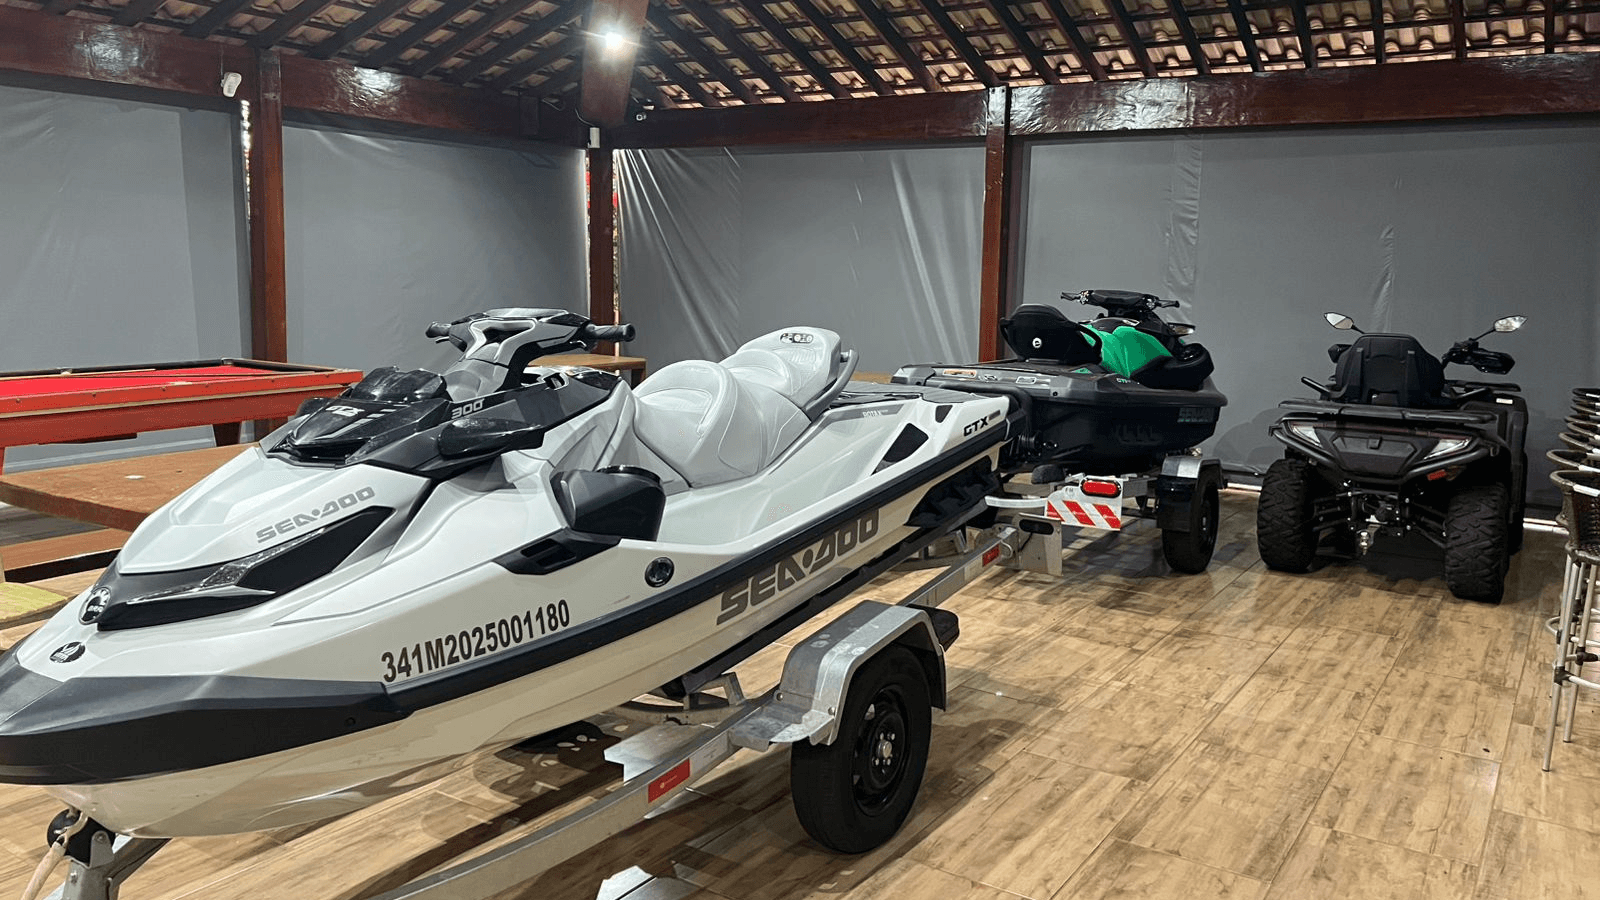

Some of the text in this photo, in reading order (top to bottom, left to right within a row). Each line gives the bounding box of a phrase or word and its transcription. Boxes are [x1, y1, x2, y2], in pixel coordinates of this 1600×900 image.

[451, 398, 485, 419] 300
[963, 416, 988, 437] GTX
[381, 599, 570, 682] 341M2025001180
